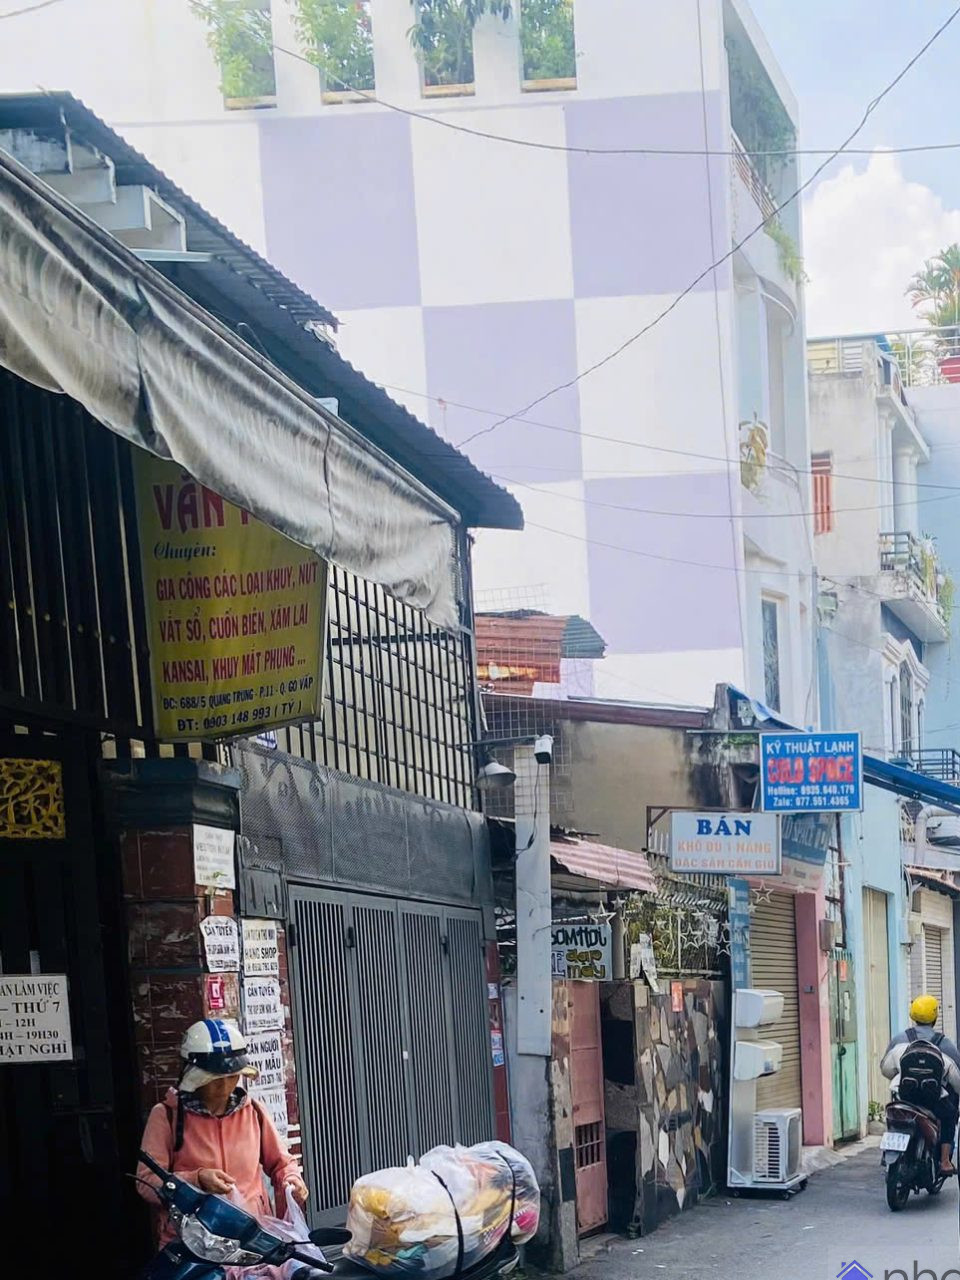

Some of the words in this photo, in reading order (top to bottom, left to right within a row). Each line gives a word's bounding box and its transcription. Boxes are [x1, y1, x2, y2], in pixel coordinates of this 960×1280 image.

[153, 542, 216, 561] Chuyên:
[156, 578, 176, 601] GIA
[179, 571, 212, 600] CÔNG
[214, 568, 237, 598] CÁC
[240, 571, 264, 599] LOẠI
[266, 565, 296, 592] KHUY,
[298, 557, 318, 586] NÚT
[209, 607, 239, 640] CUỐN
[162, 659, 209, 685] KANSAI,
[213, 656, 239, 681] KHUY
[208, 692, 231, 709] QUANG
[232, 688, 254, 703] TRUNG
[177, 718, 199, 731] ĐT:
[203, 714, 228, 729] 0903
[231, 710, 249, 726] 148
[252, 706, 271, 721] 993
[766, 740, 781, 754] KỸ
[784, 739, 821, 756] THUẬT
[824, 741, 854, 755] LẠNH
[697, 816, 752, 836] BÁN
[261, 946, 277, 960] SHOP
[14, 980, 35, 996] LÀM
[37, 982, 60, 998] VIỆC
[12, 998, 49, 1013] THỨ
[53, 1001, 60, 1013] 7
[27, 1030, 59, 1040] 19H30
